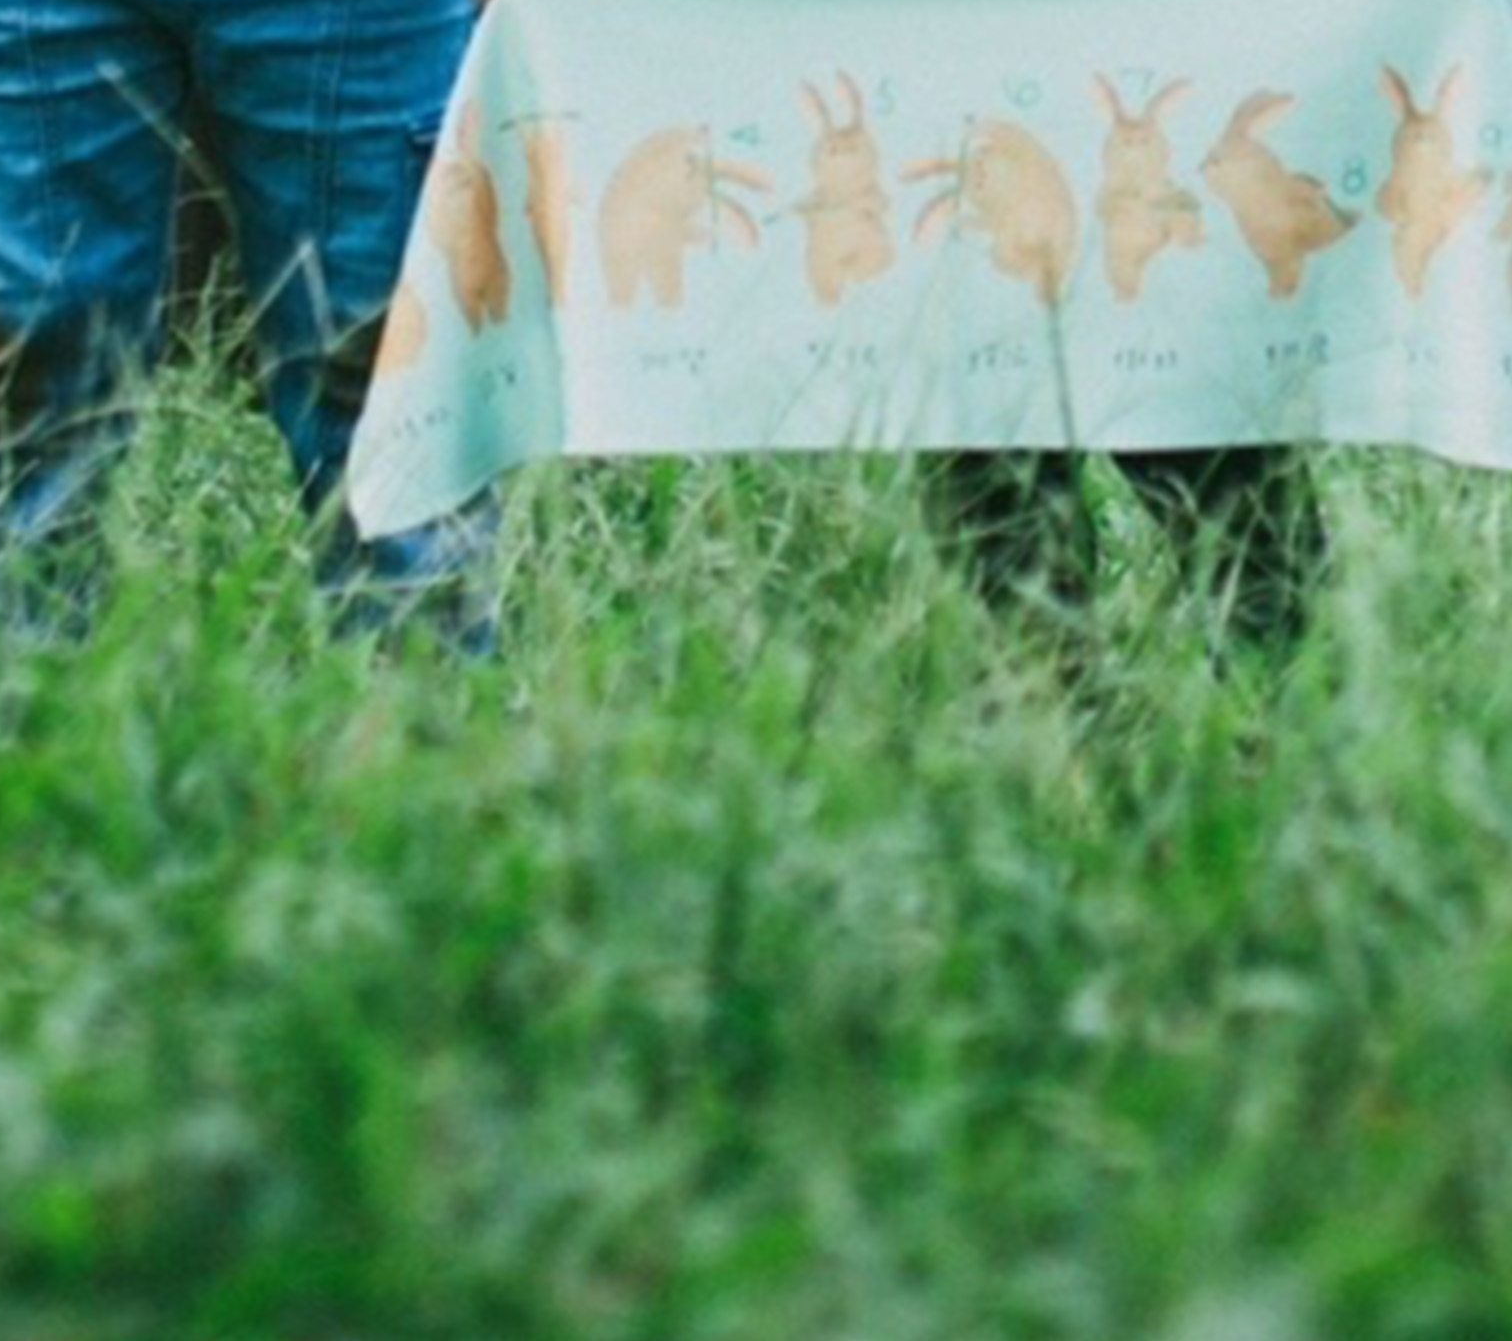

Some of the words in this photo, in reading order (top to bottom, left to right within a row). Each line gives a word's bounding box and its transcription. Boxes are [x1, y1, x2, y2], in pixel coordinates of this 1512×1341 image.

[875, 75, 897, 116] 5
[1001, 75, 1043, 109] 6
[1118, 67, 1156, 97] 7
[1342, 155, 1367, 195] 8
